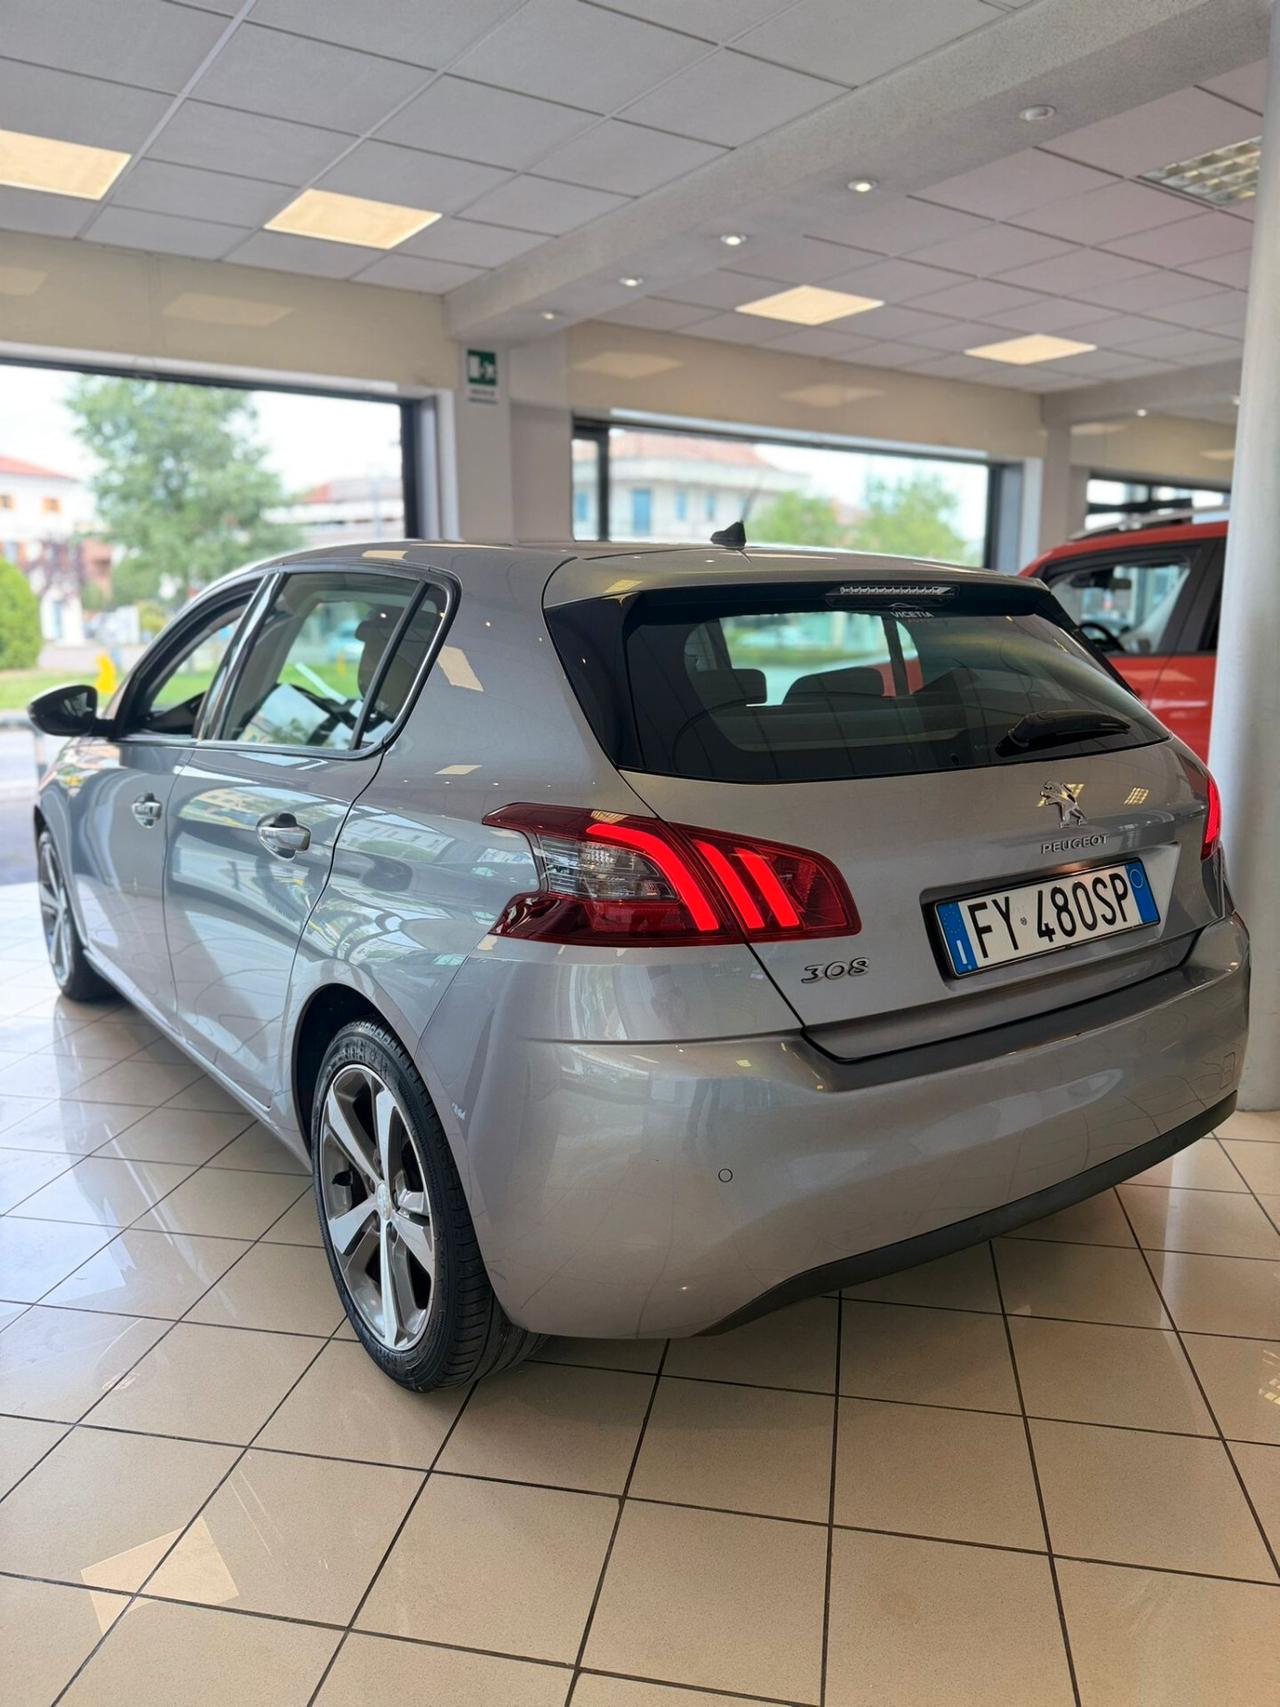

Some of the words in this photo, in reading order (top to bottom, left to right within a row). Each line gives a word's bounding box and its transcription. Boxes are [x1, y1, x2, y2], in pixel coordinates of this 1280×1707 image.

[1041, 833, 1110, 854] PEUGEOT
[967, 896, 1019, 958] FY
[1037, 872, 1128, 943] 480SP
[801, 957, 871, 984] 308
